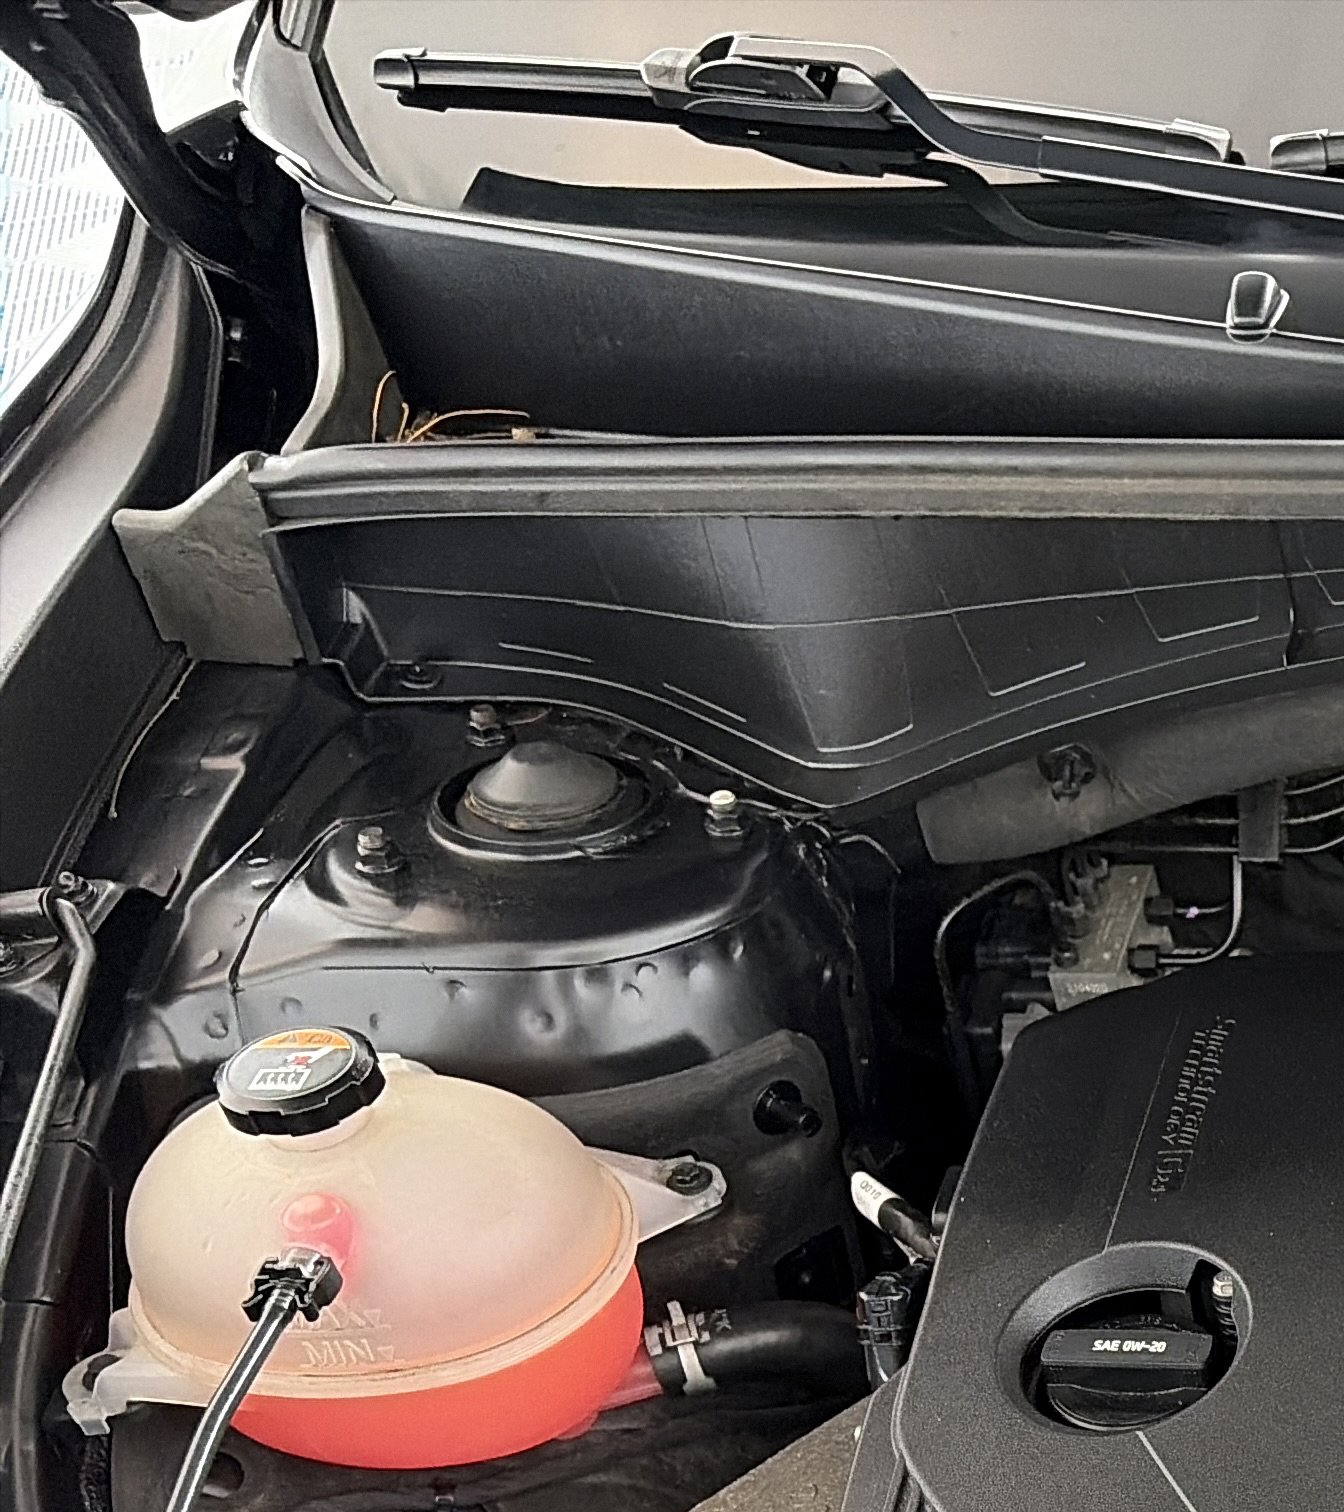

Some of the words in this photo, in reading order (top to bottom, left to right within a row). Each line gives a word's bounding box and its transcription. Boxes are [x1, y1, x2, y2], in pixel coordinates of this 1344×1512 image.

[300, 1338, 376, 1368] MIN
[1091, 1339, 1122, 1352] SAE
[1122, 1340, 1167, 1353] 0W-20
